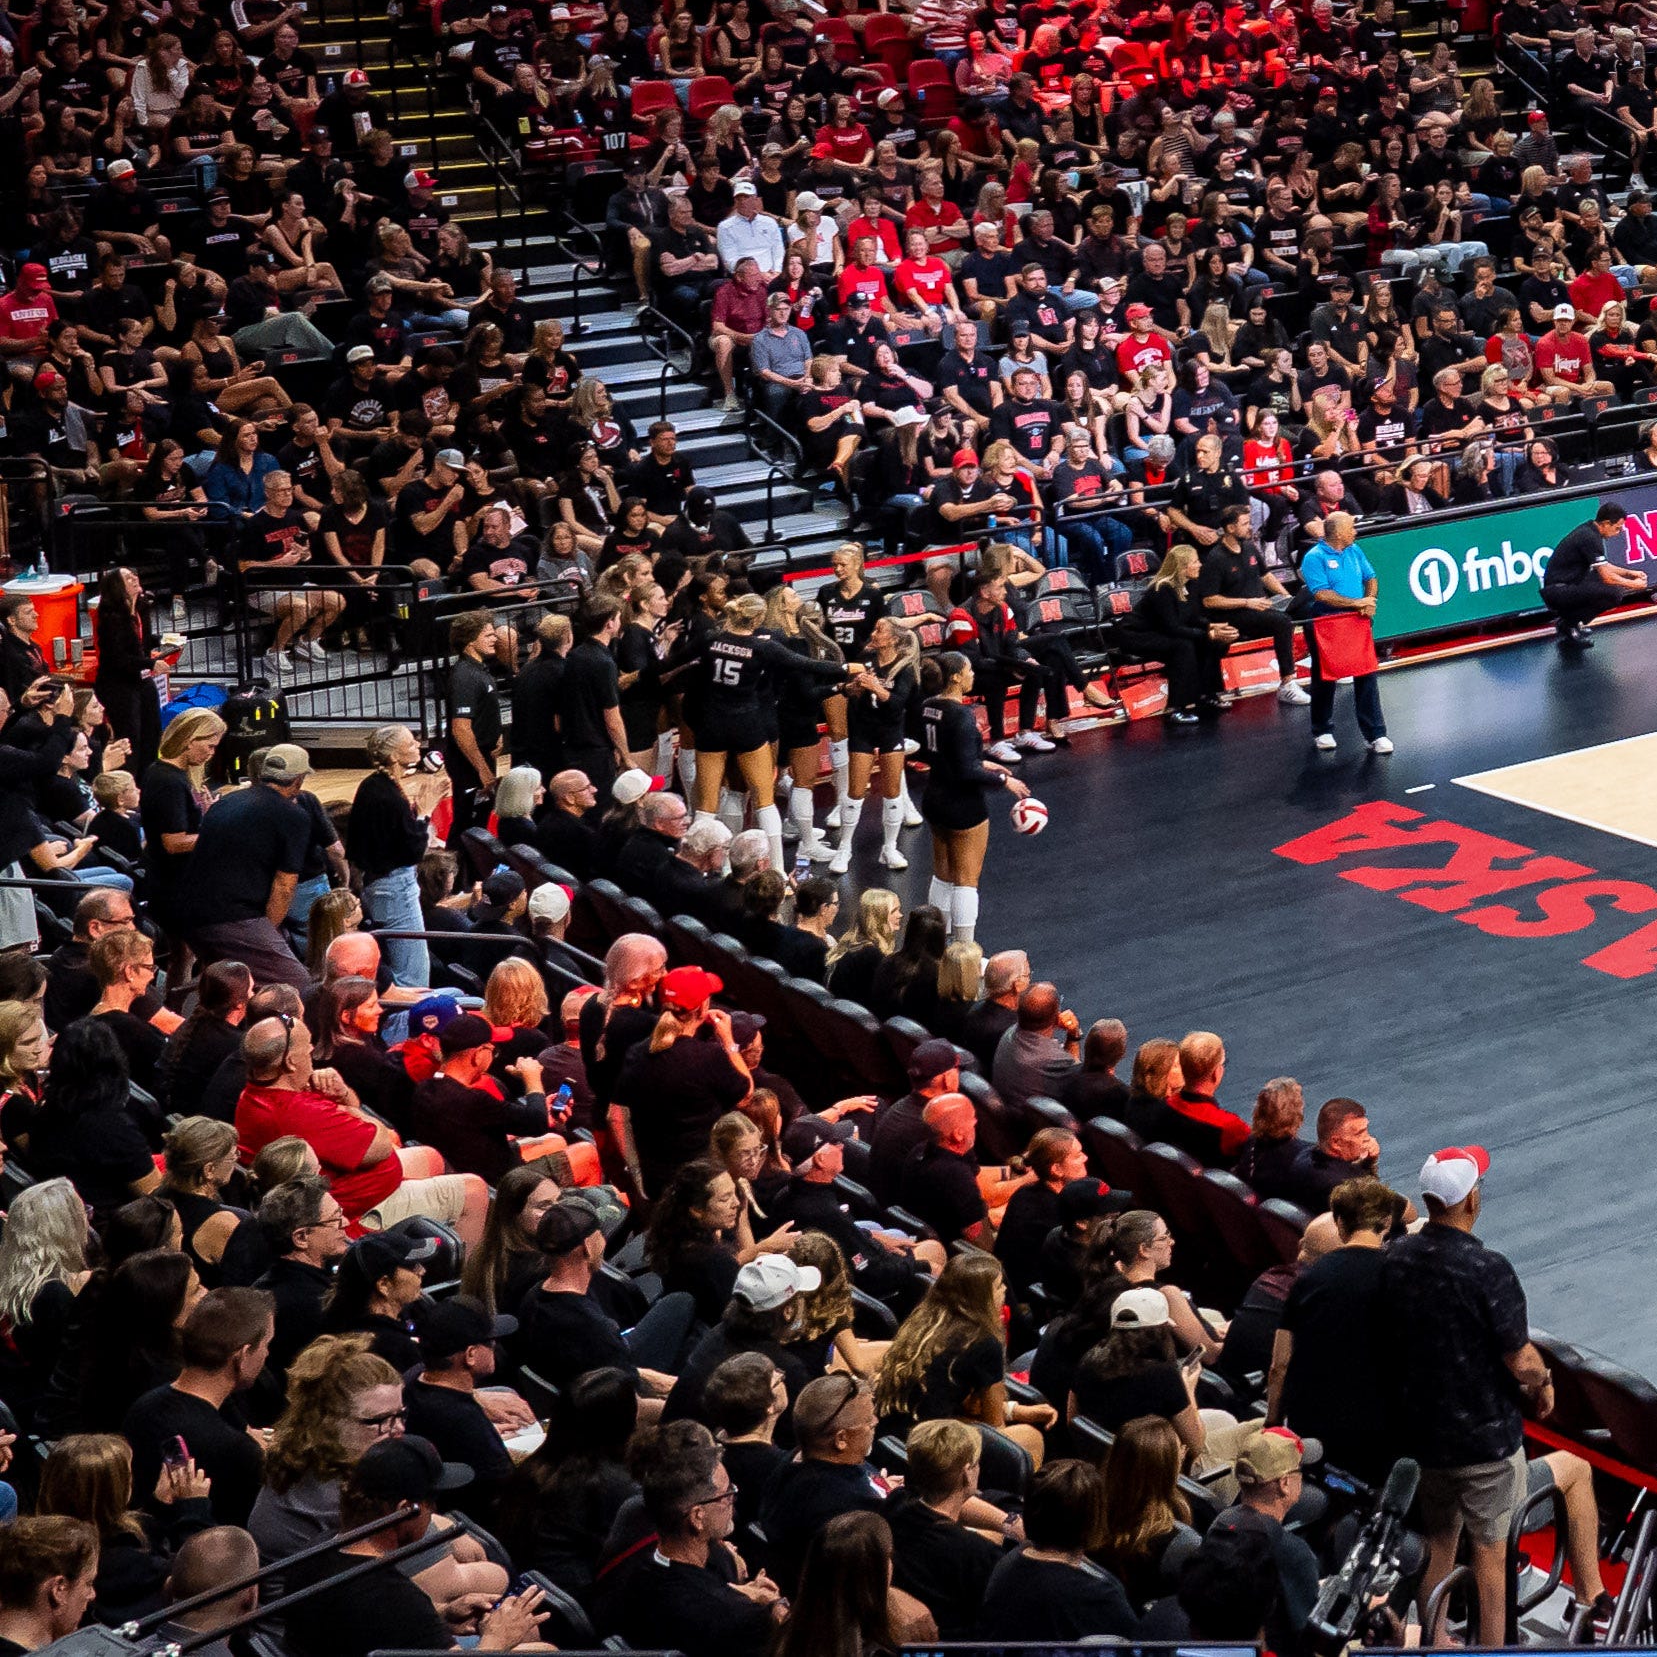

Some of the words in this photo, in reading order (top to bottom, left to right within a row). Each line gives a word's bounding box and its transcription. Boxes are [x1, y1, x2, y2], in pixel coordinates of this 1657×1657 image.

[604, 132, 625, 149] 107
[835, 627, 854, 643] 23
[710, 642, 752, 657] JACKSON
[714, 659, 742, 685] 15
